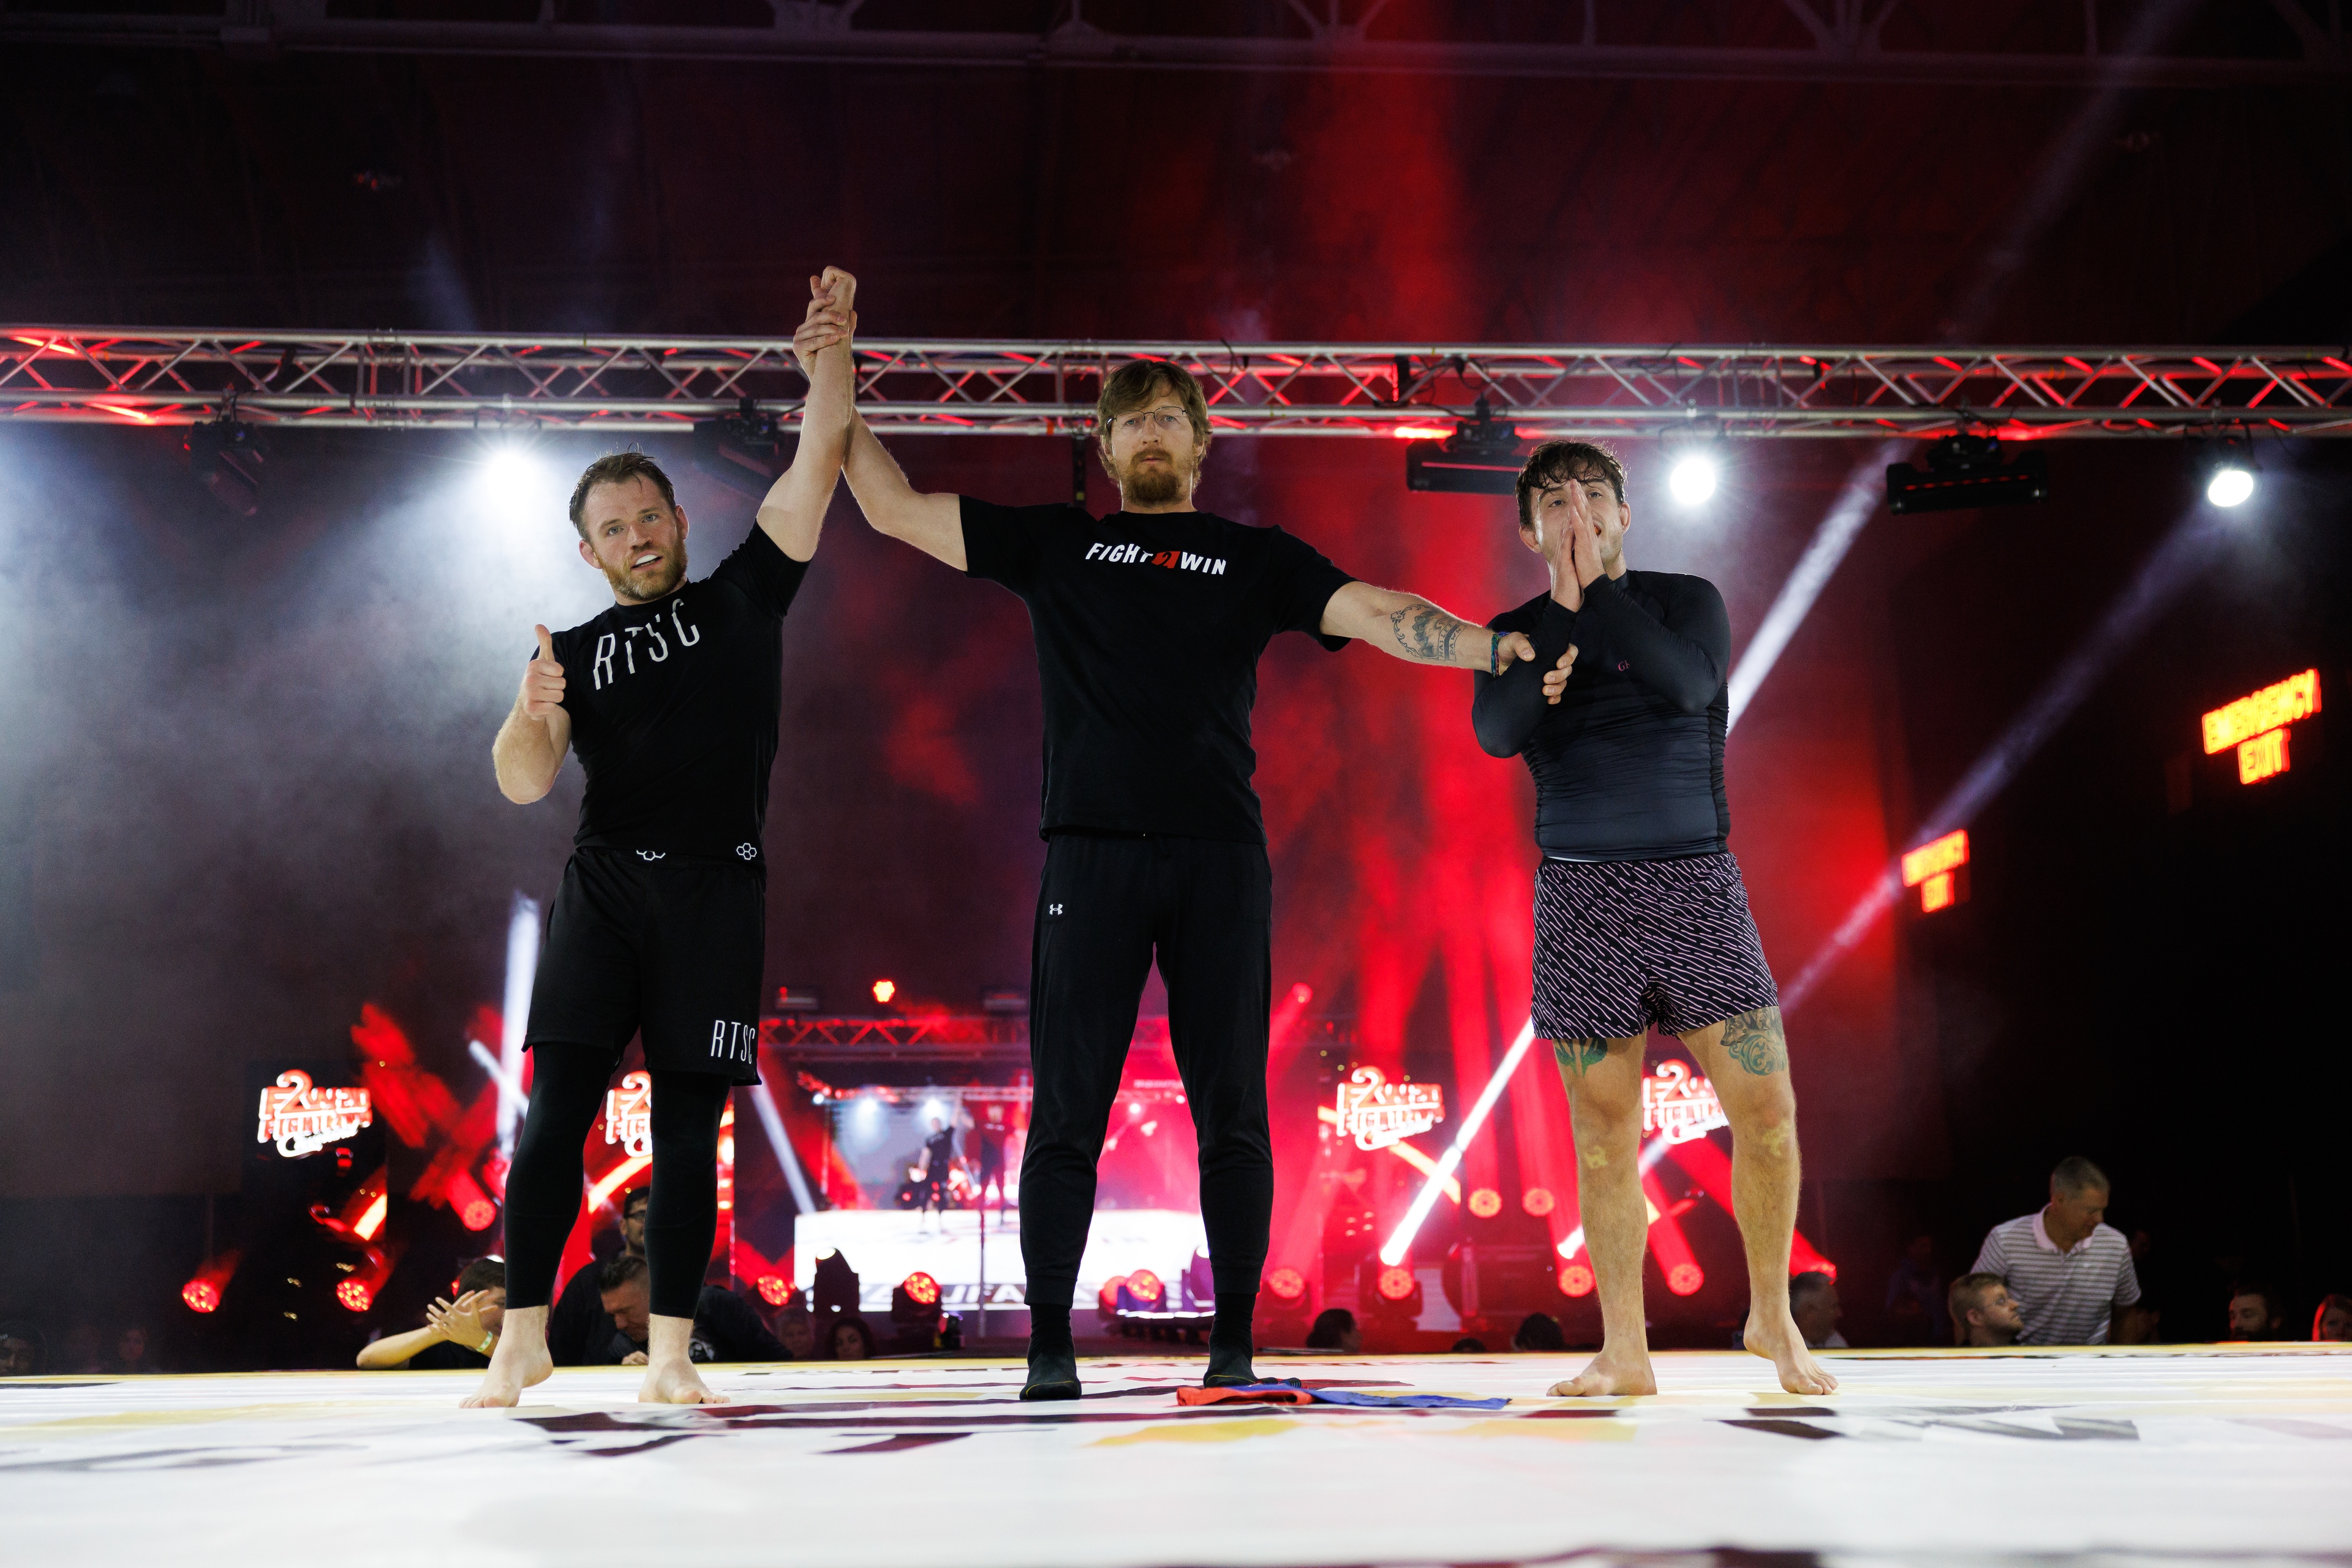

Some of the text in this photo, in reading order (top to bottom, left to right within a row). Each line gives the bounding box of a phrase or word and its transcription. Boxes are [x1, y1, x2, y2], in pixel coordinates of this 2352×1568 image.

[1085, 543, 1153, 563] FIGHT
[1181, 551, 1226, 575] WIN
[593, 598, 700, 690] RTSC
[2237, 728, 2291, 784] EXIT
[710, 1020, 755, 1065] RTSC
